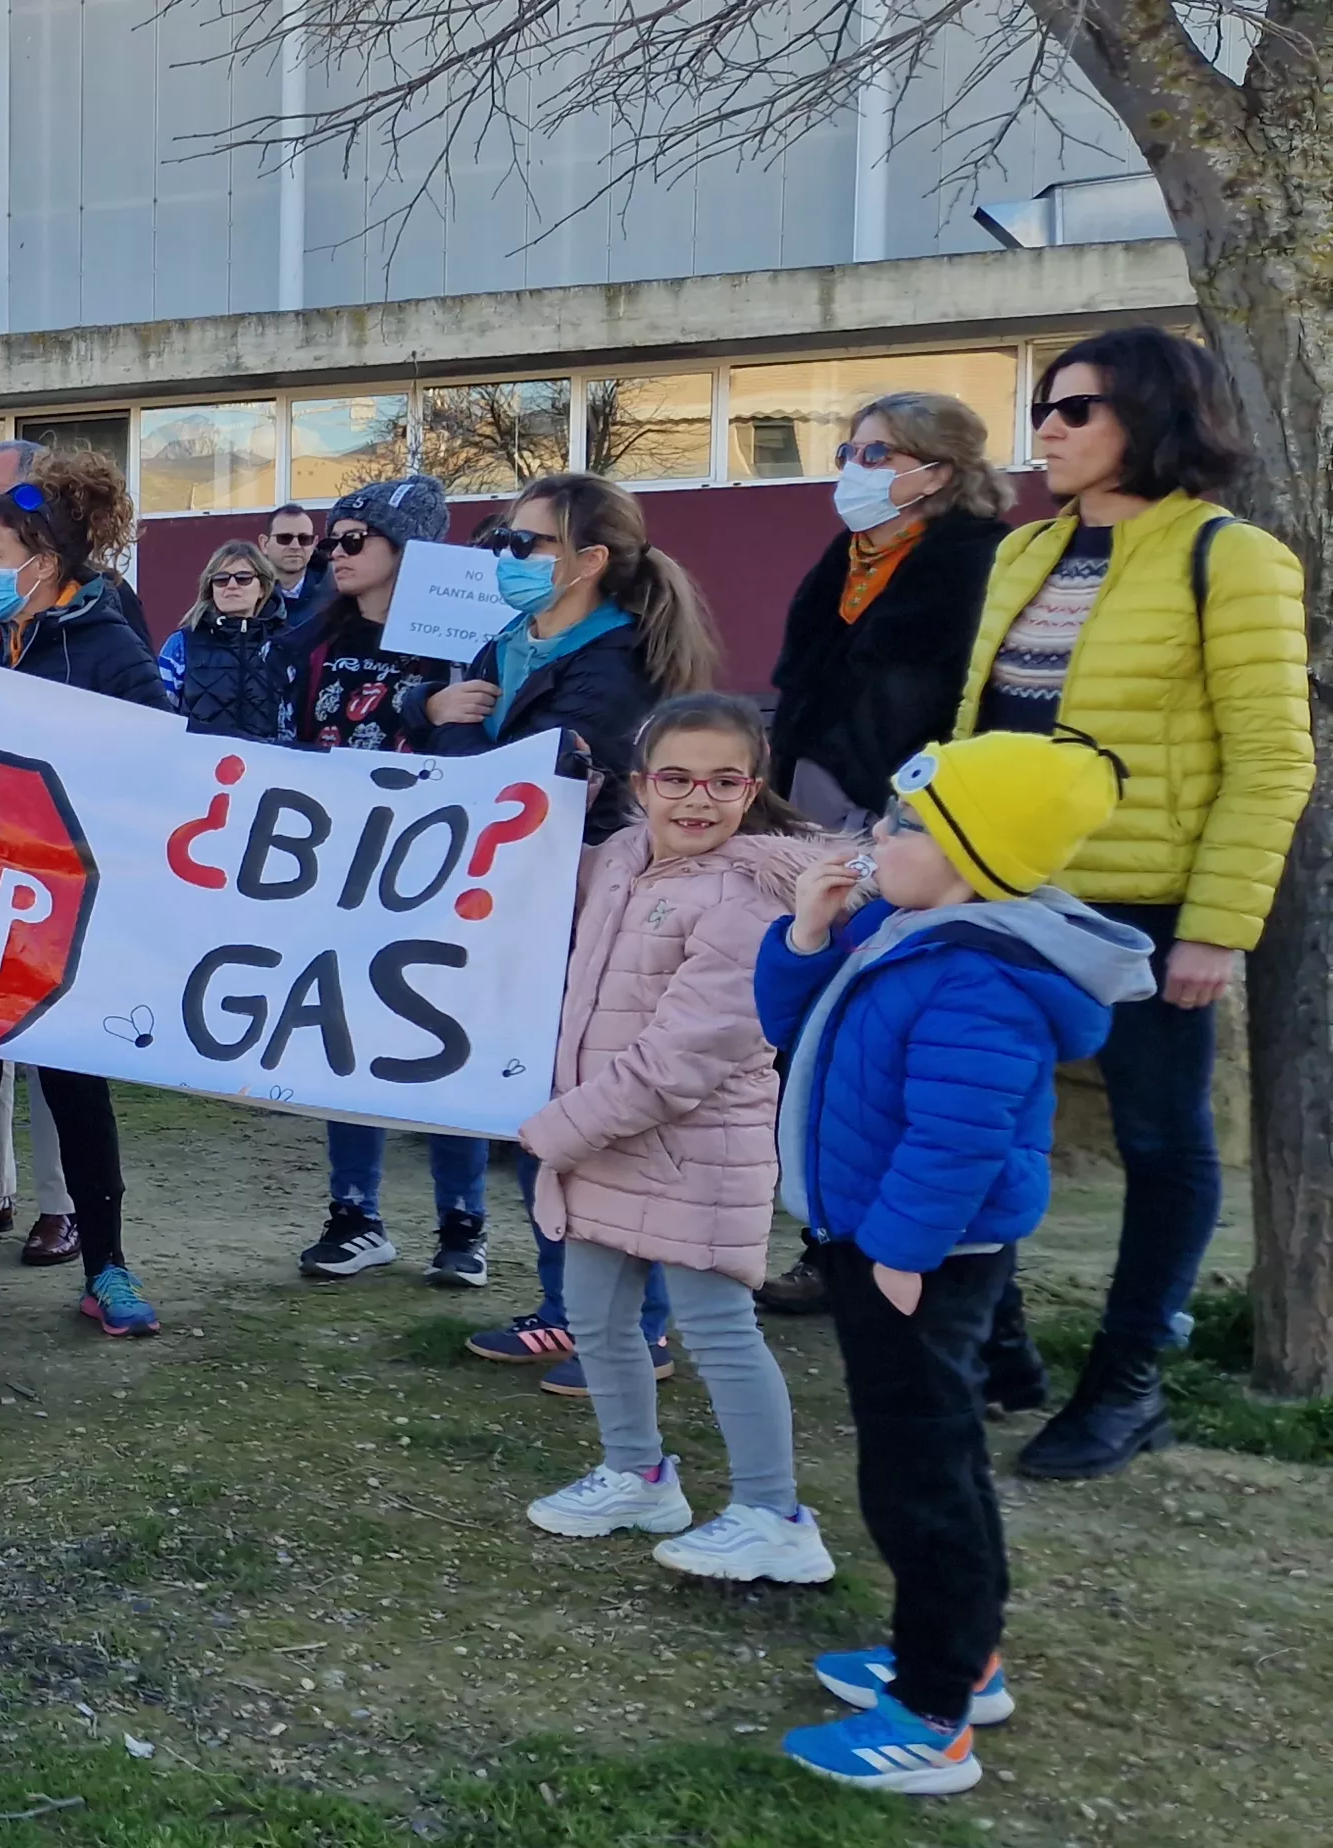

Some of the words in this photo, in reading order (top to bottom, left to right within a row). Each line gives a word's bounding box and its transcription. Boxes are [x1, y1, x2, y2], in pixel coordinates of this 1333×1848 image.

[465, 570, 484, 582] NO
[429, 585, 475, 601] PLANTA
[410, 622, 442, 637] STOP,
[445, 627, 478, 643] STOP,
[182, 939, 472, 1084] GAS
